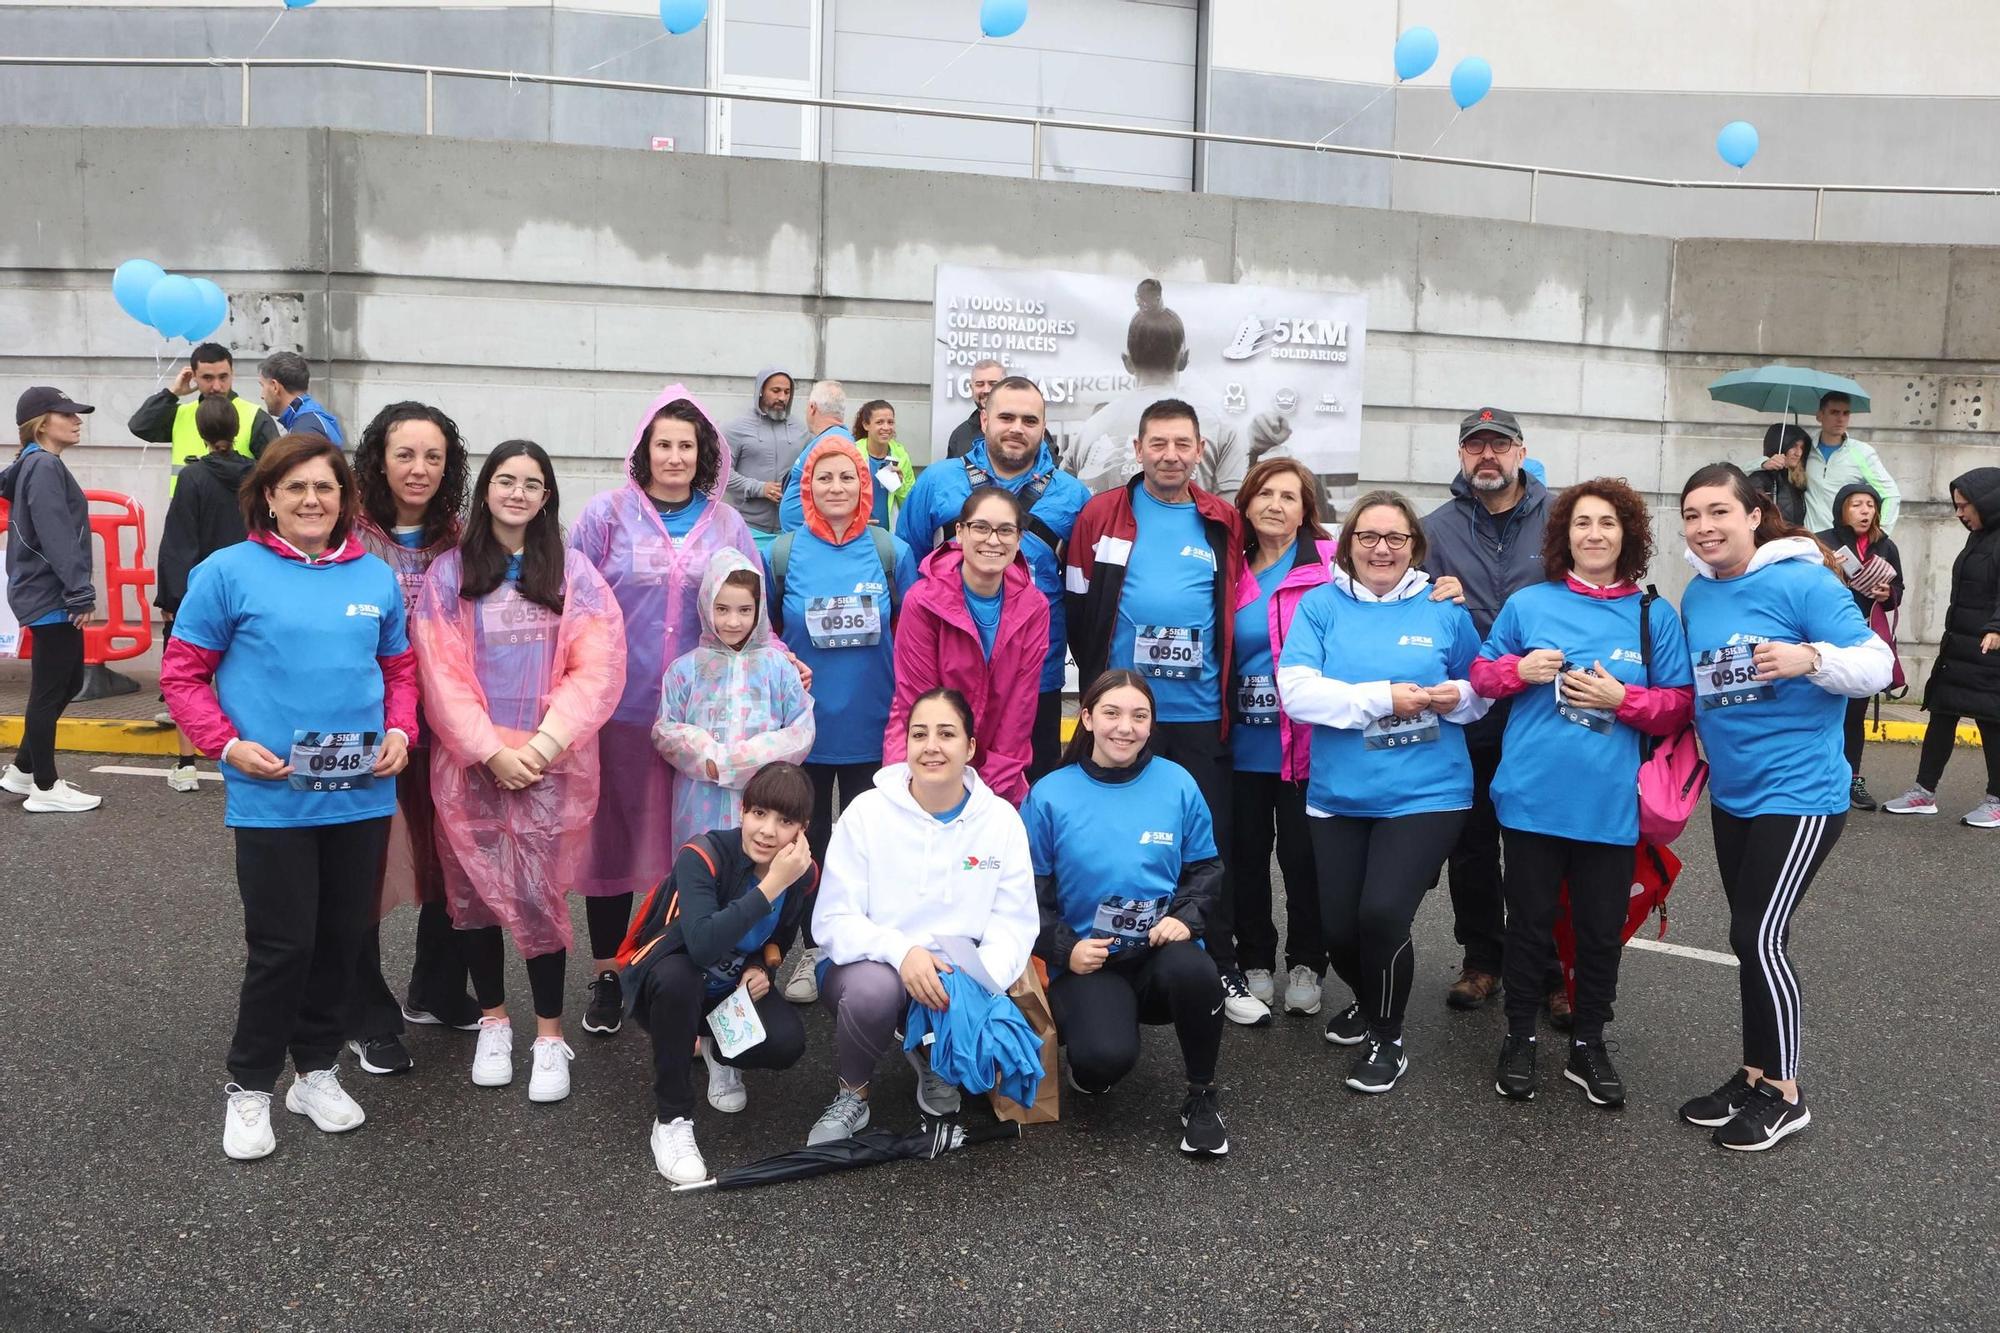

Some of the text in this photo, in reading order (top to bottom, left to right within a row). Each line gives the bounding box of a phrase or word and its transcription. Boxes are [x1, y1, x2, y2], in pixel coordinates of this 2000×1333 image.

[948, 296, 1045, 315] A TODOS LOS
[947, 312, 1076, 336] COLABORADORES
[1272, 318, 1348, 347] 5KM
[947, 331, 1057, 353] QUE LO HACÉIS
[1270, 346, 1347, 362] SOLIDARIOS
[946, 371, 1074, 404] ¡GAS!
[1314, 404, 1345, 413] AGRELA
[821, 614, 865, 631] 0936
[1149, 645, 1192, 661] 0950
[1725, 646, 1748, 656] 5KM
[1711, 665, 1757, 688] 0958
[1240, 693, 1276, 708] 0949
[336, 733, 361, 743] 5KM
[309, 753, 361, 771] 0948
[979, 855, 1001, 870] elis
